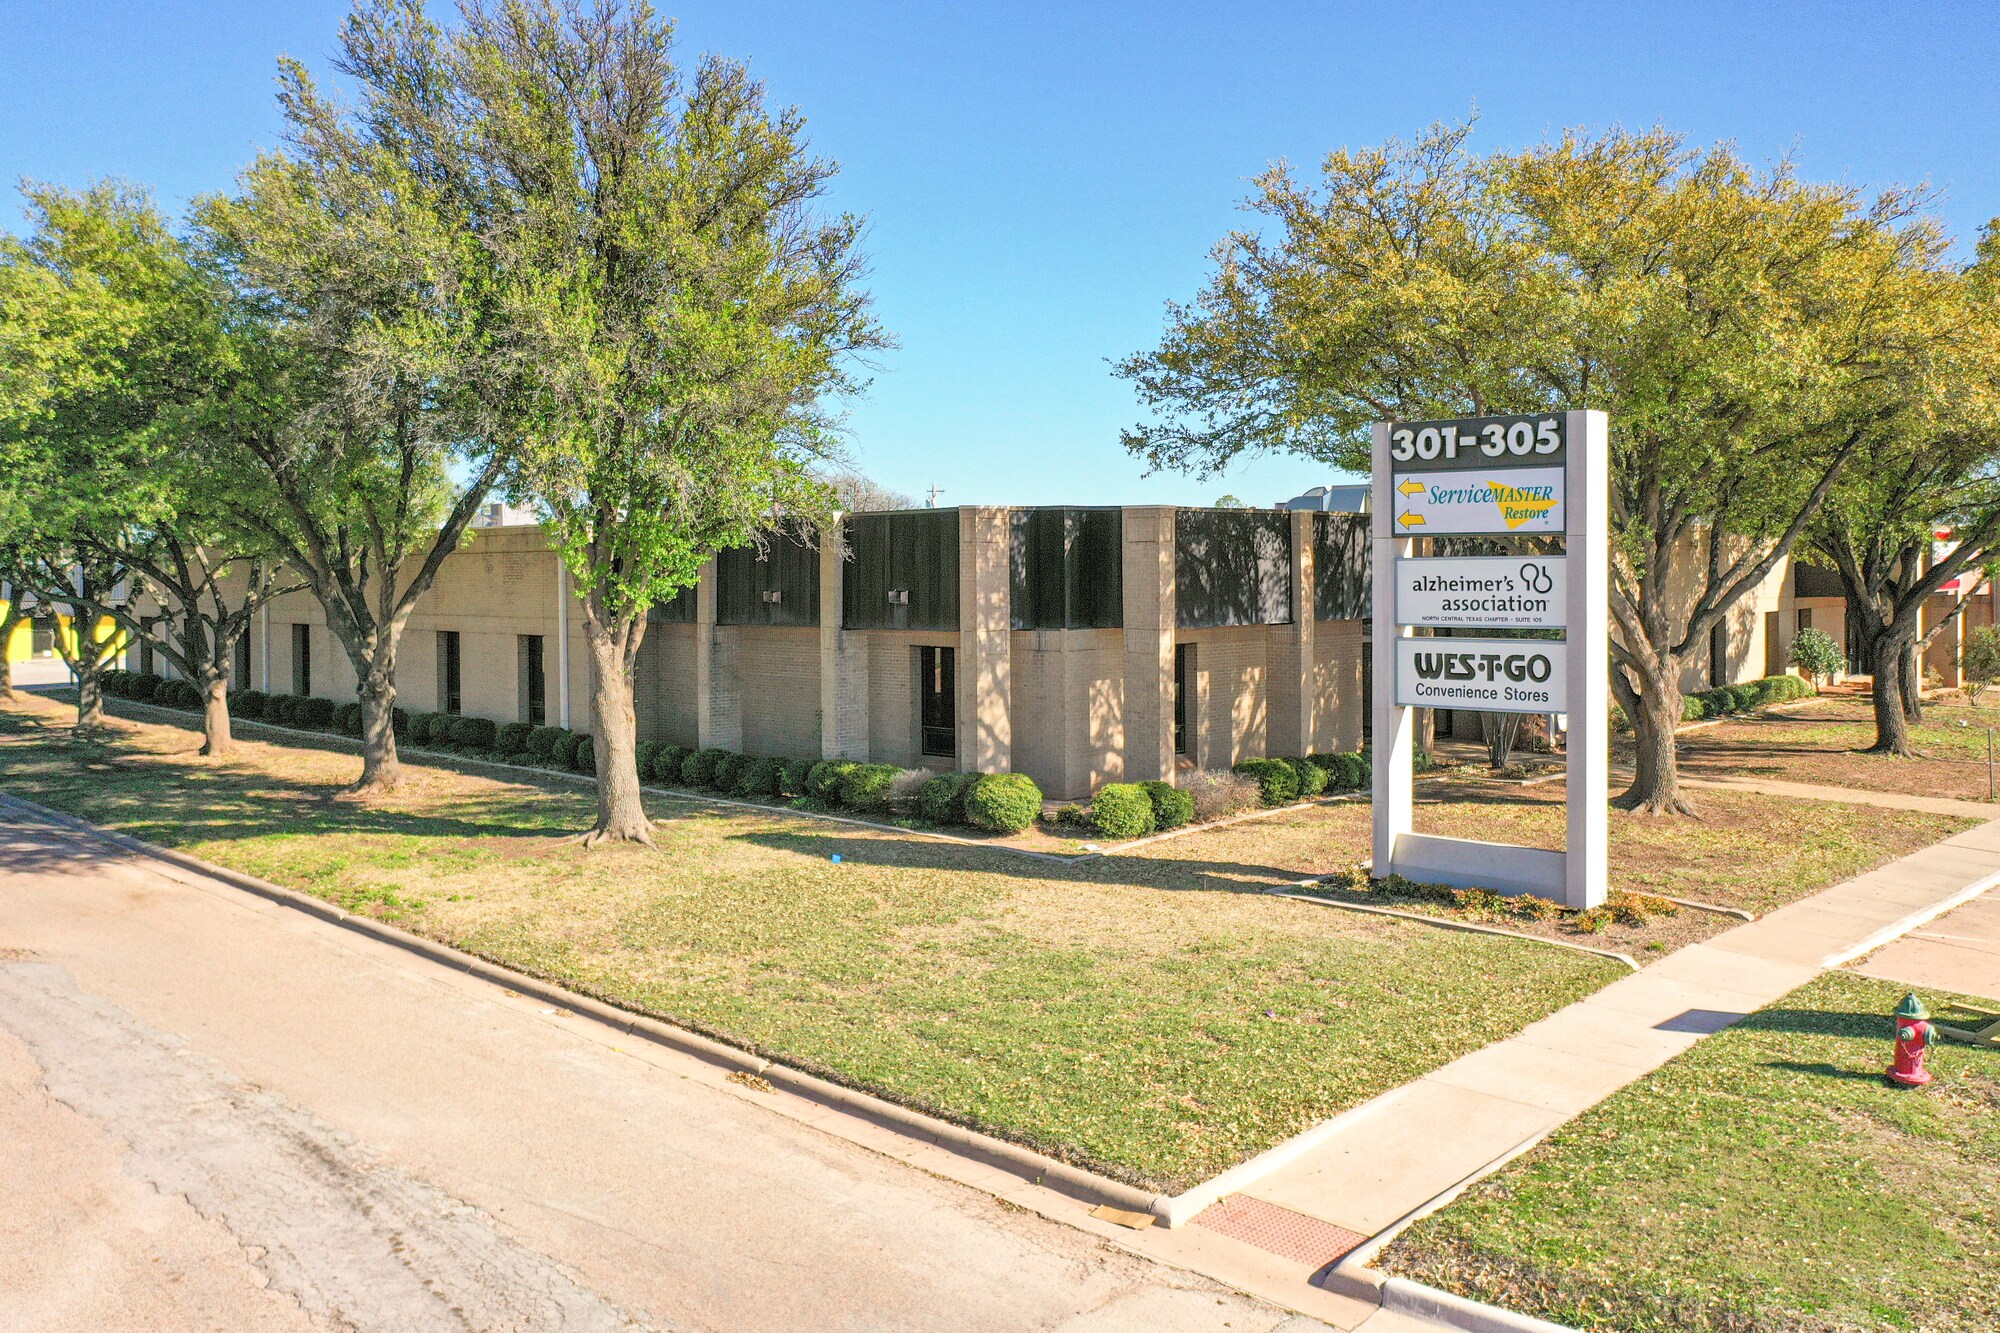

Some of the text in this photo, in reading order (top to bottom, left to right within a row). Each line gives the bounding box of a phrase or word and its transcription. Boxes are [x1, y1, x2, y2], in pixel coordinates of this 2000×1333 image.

[1391, 420, 1561, 461] 301-305
[1428, 484, 1553, 505] ServiceMASTER
[1504, 507, 1549, 520] Restore
[1412, 576, 1514, 592] alzheimer's
[1442, 595, 1547, 612] association
[1415, 683, 1549, 702] Convenience Stores
